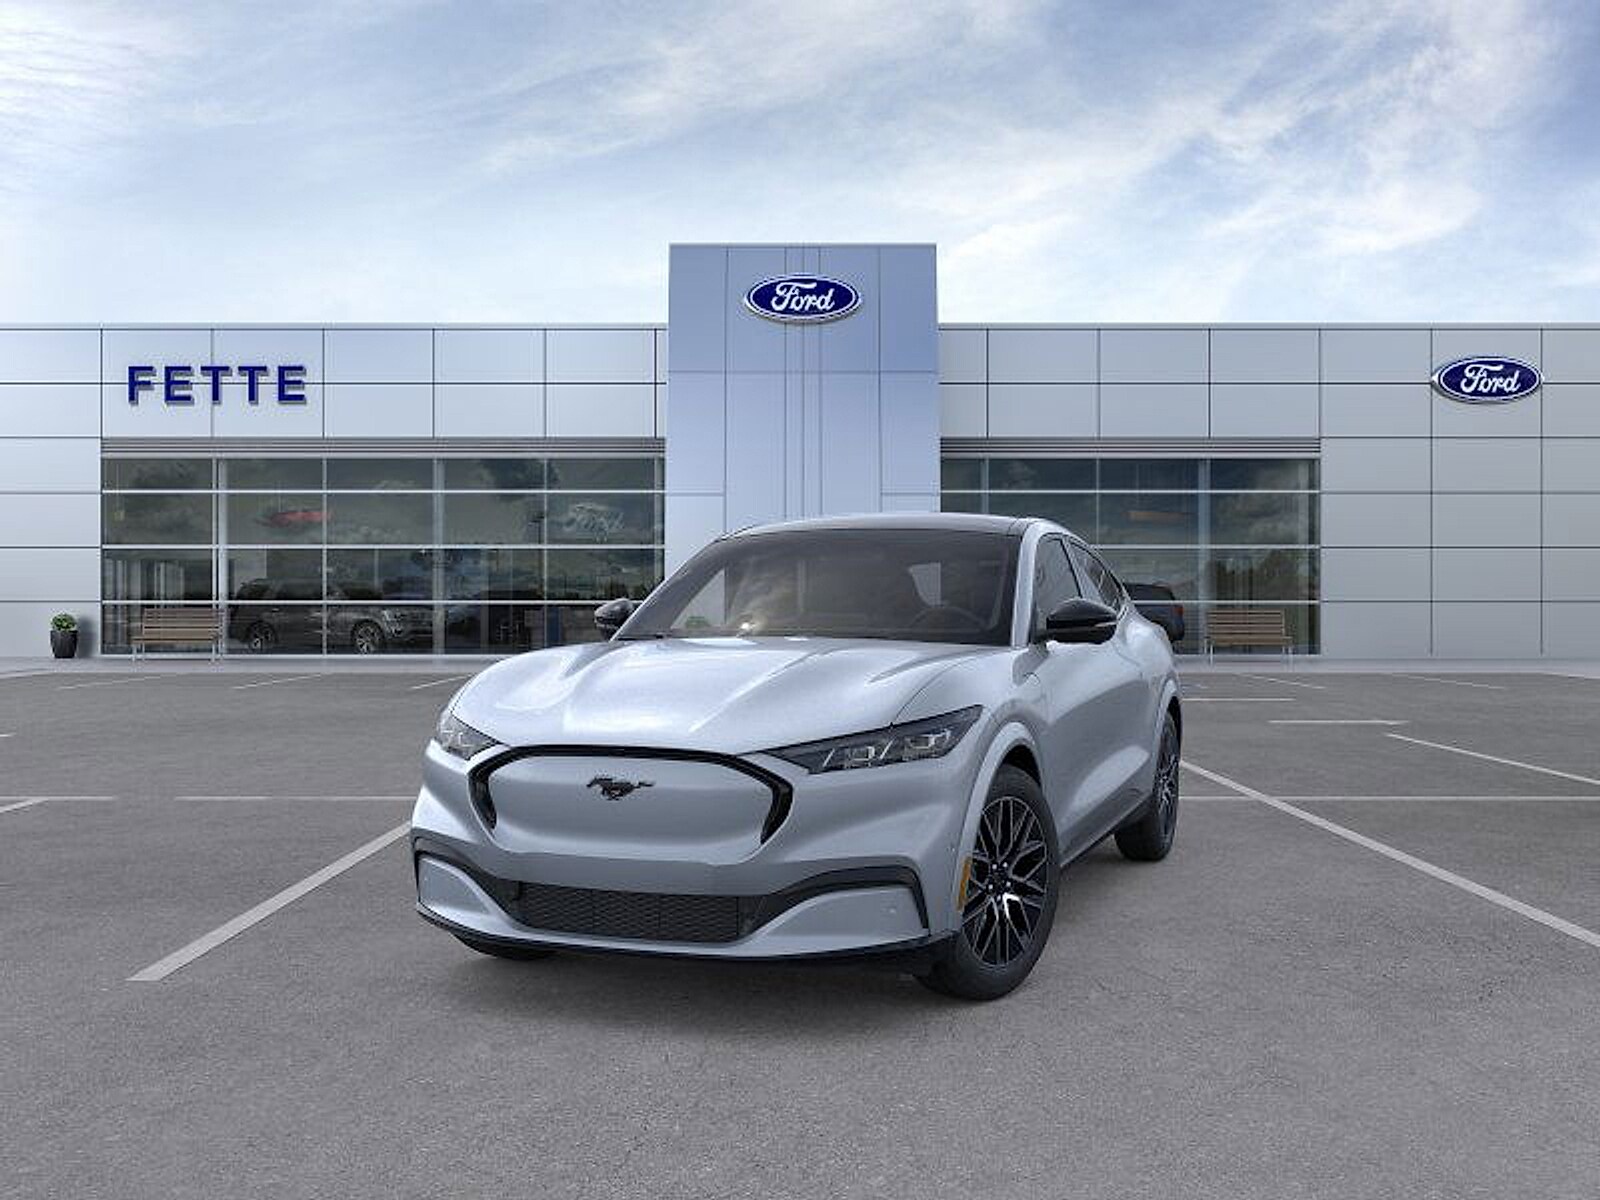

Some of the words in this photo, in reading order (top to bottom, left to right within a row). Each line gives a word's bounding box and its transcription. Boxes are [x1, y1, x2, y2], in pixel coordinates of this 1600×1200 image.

[770, 281, 835, 311] Ford
[127, 365, 307, 405] FETTE
[1460, 364, 1521, 393] Ford
